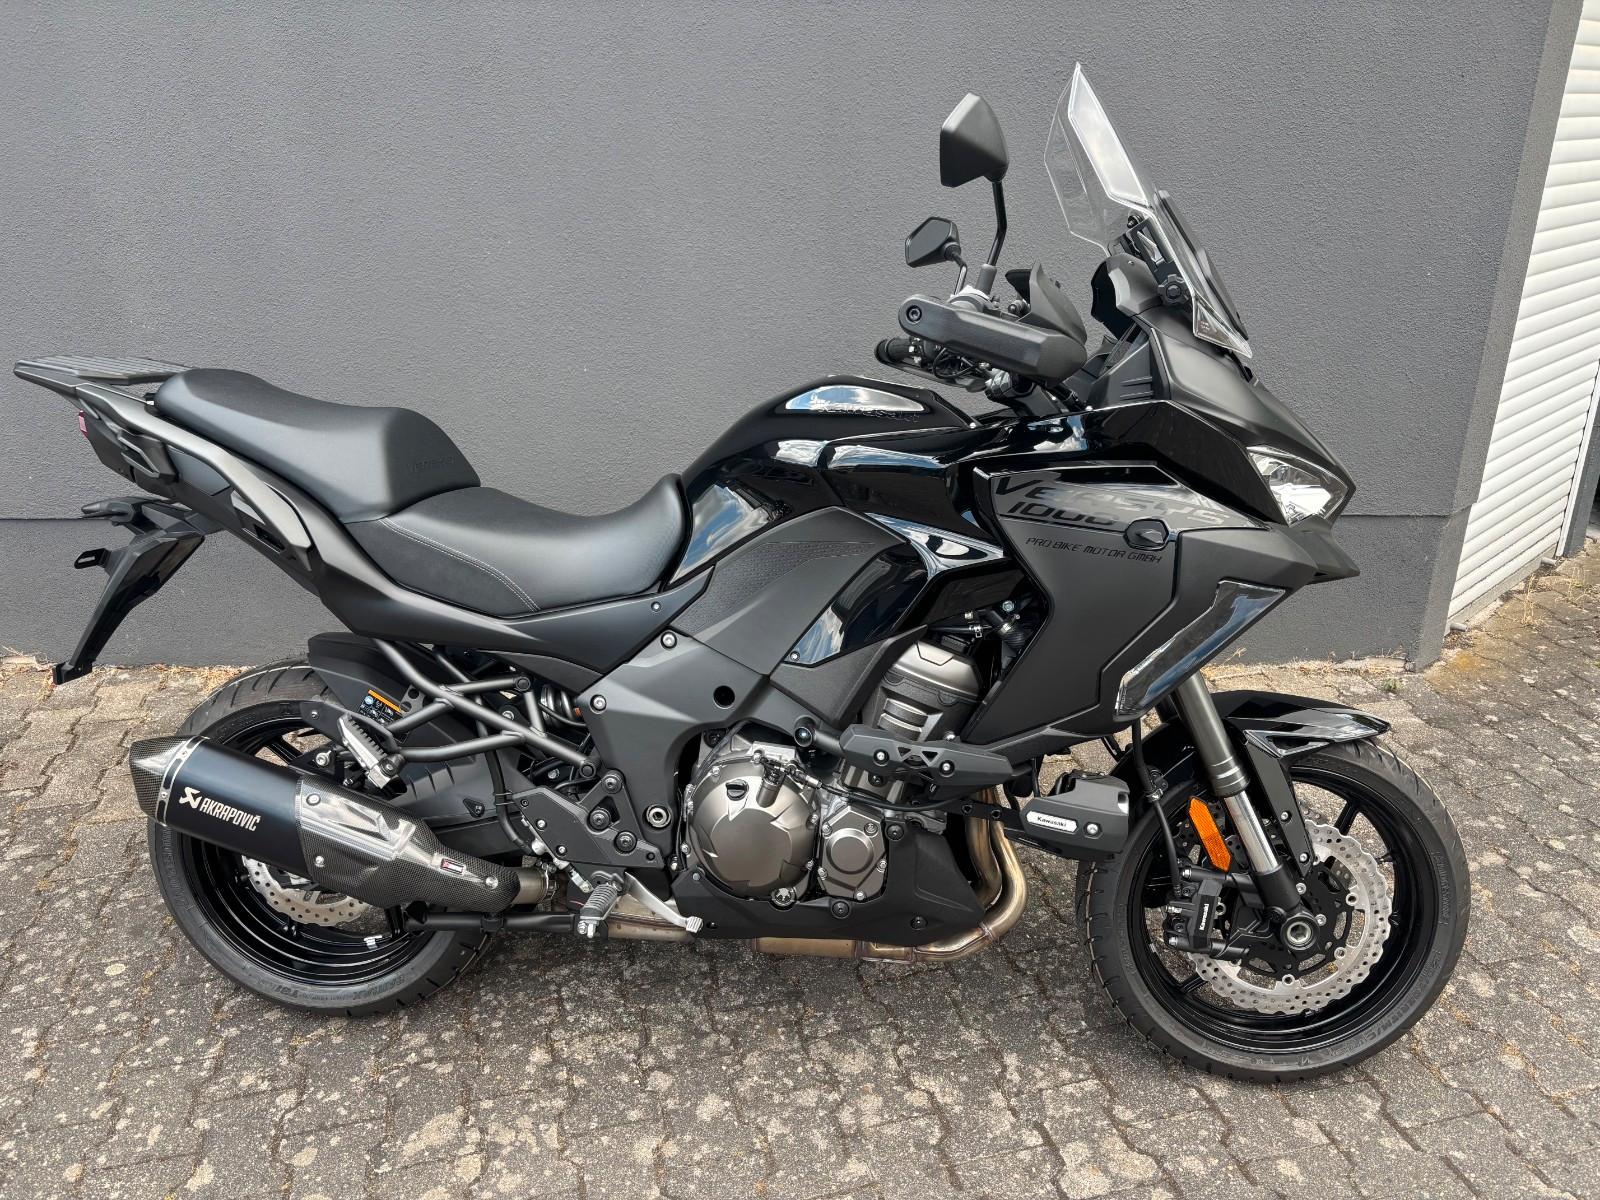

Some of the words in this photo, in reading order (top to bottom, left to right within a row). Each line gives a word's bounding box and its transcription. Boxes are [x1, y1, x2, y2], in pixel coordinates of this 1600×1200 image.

[1007, 501, 1119, 526] 1000
[1025, 537, 1050, 548] PRO
[1052, 540, 1082, 552] BIKE
[1083, 545, 1126, 559] MOTOR
[1037, 816, 1067, 827] Kawasaki
